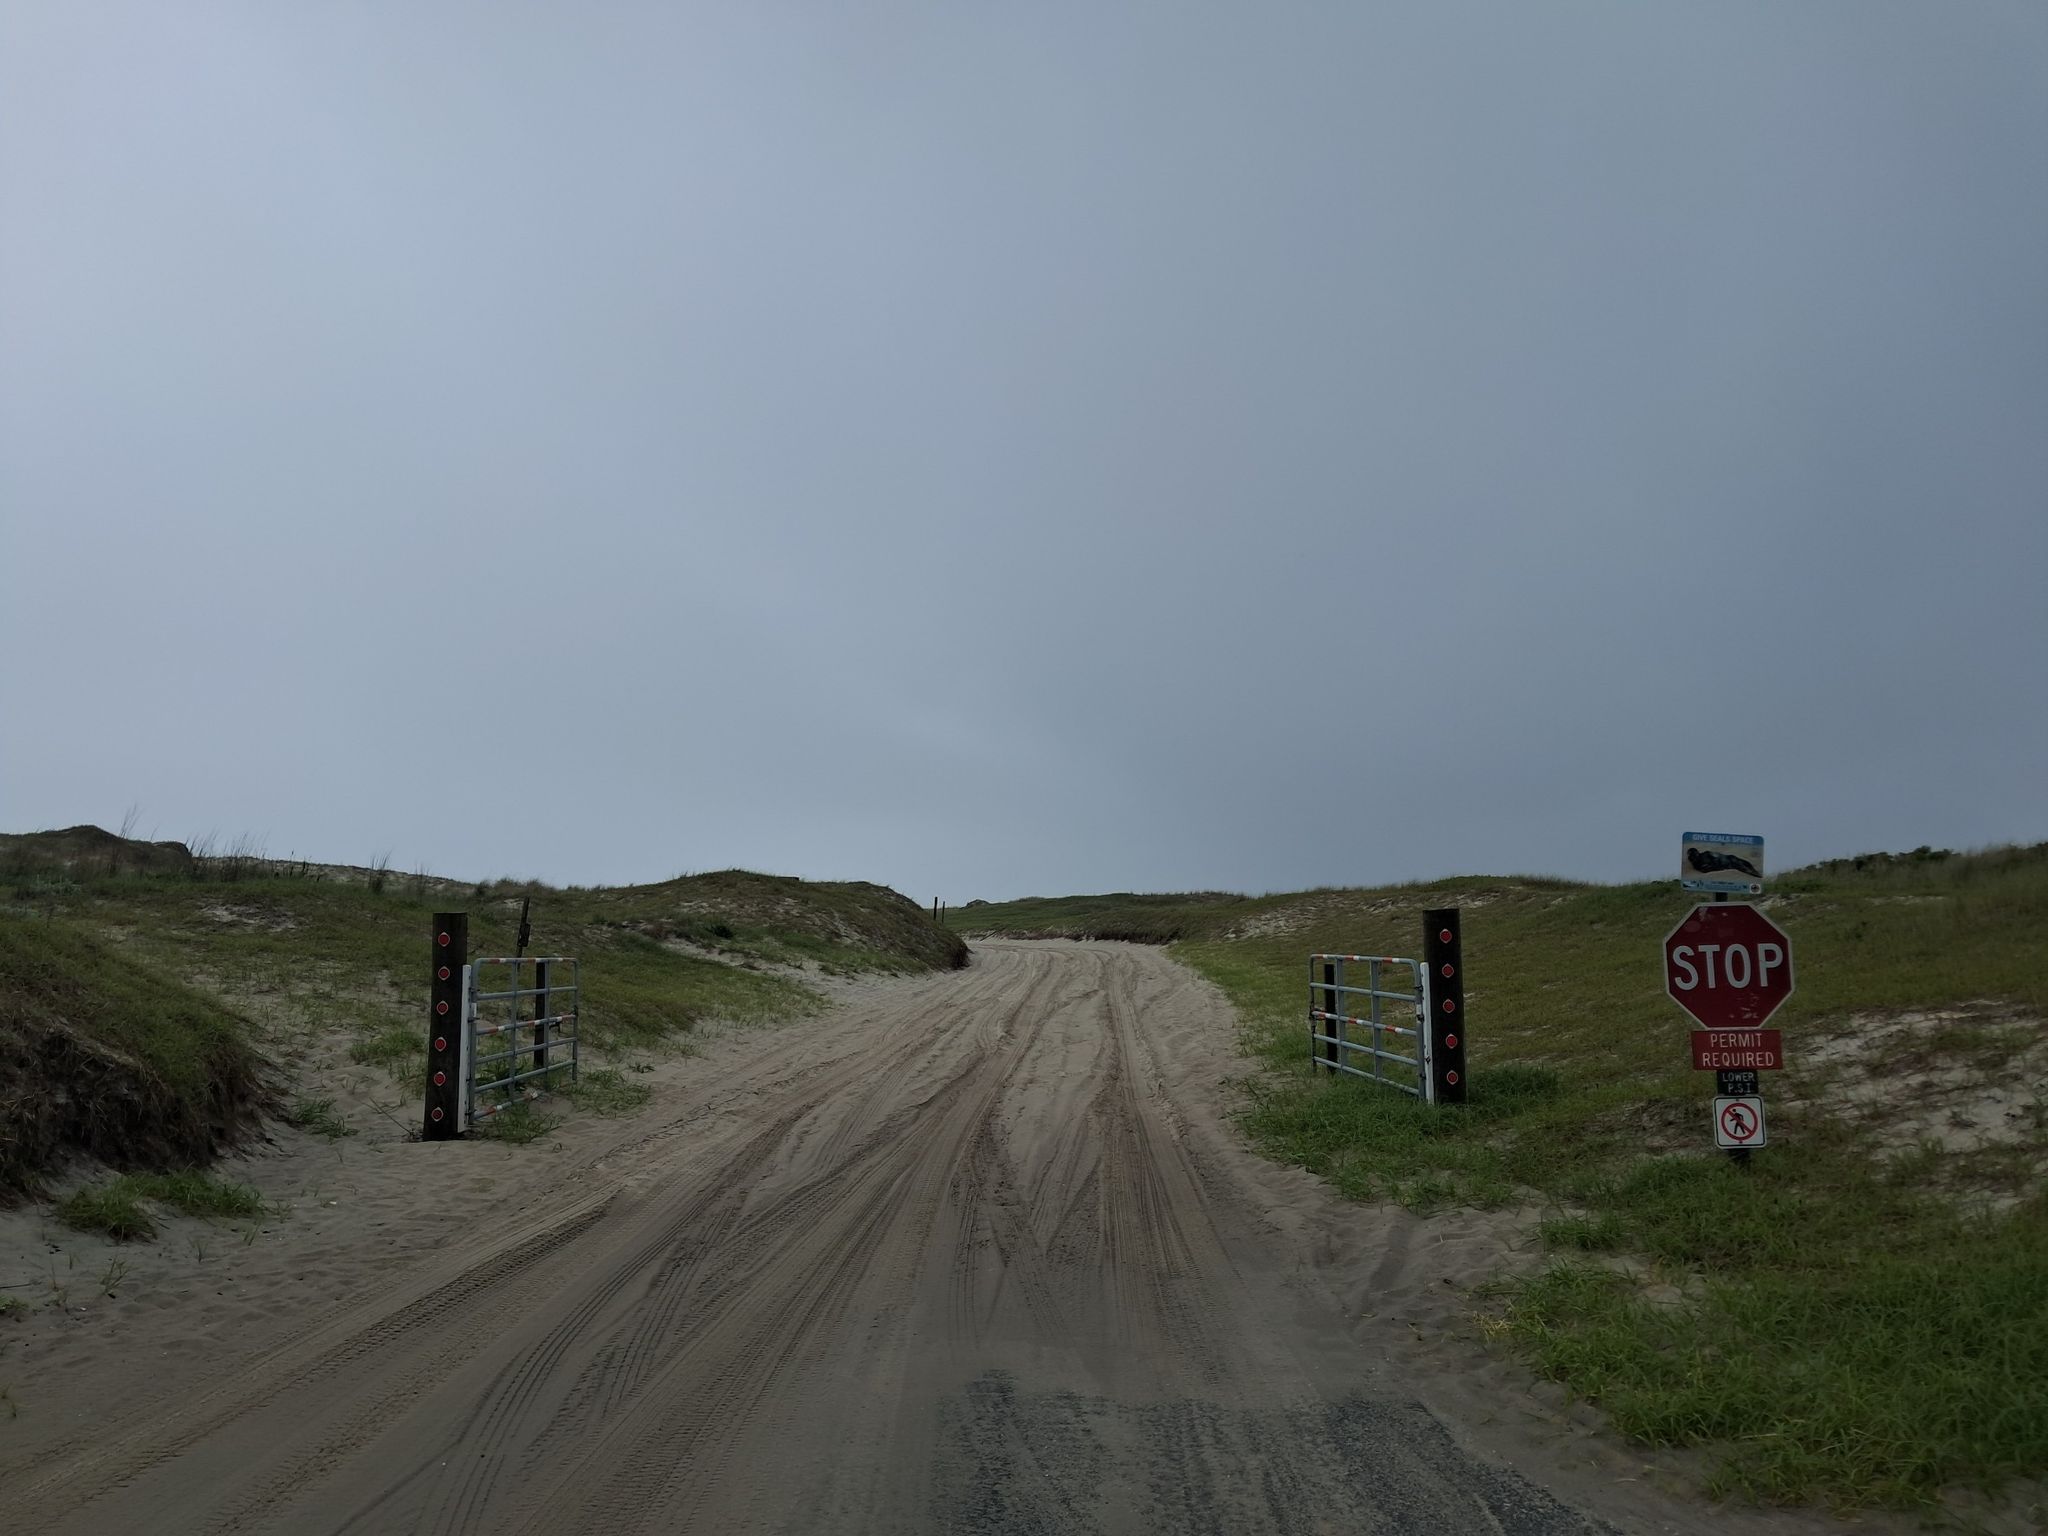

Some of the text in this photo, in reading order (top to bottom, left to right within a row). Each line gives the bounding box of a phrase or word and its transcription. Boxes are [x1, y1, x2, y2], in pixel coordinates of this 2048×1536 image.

[1692, 834, 1708, 842] GIVE
[1672, 943, 1784, 991] STOP
[1710, 1033, 1762, 1048] PERMIT
[1702, 1052, 1774, 1067] REQUIRED
[1722, 1072, 1755, 1082] LOWER
